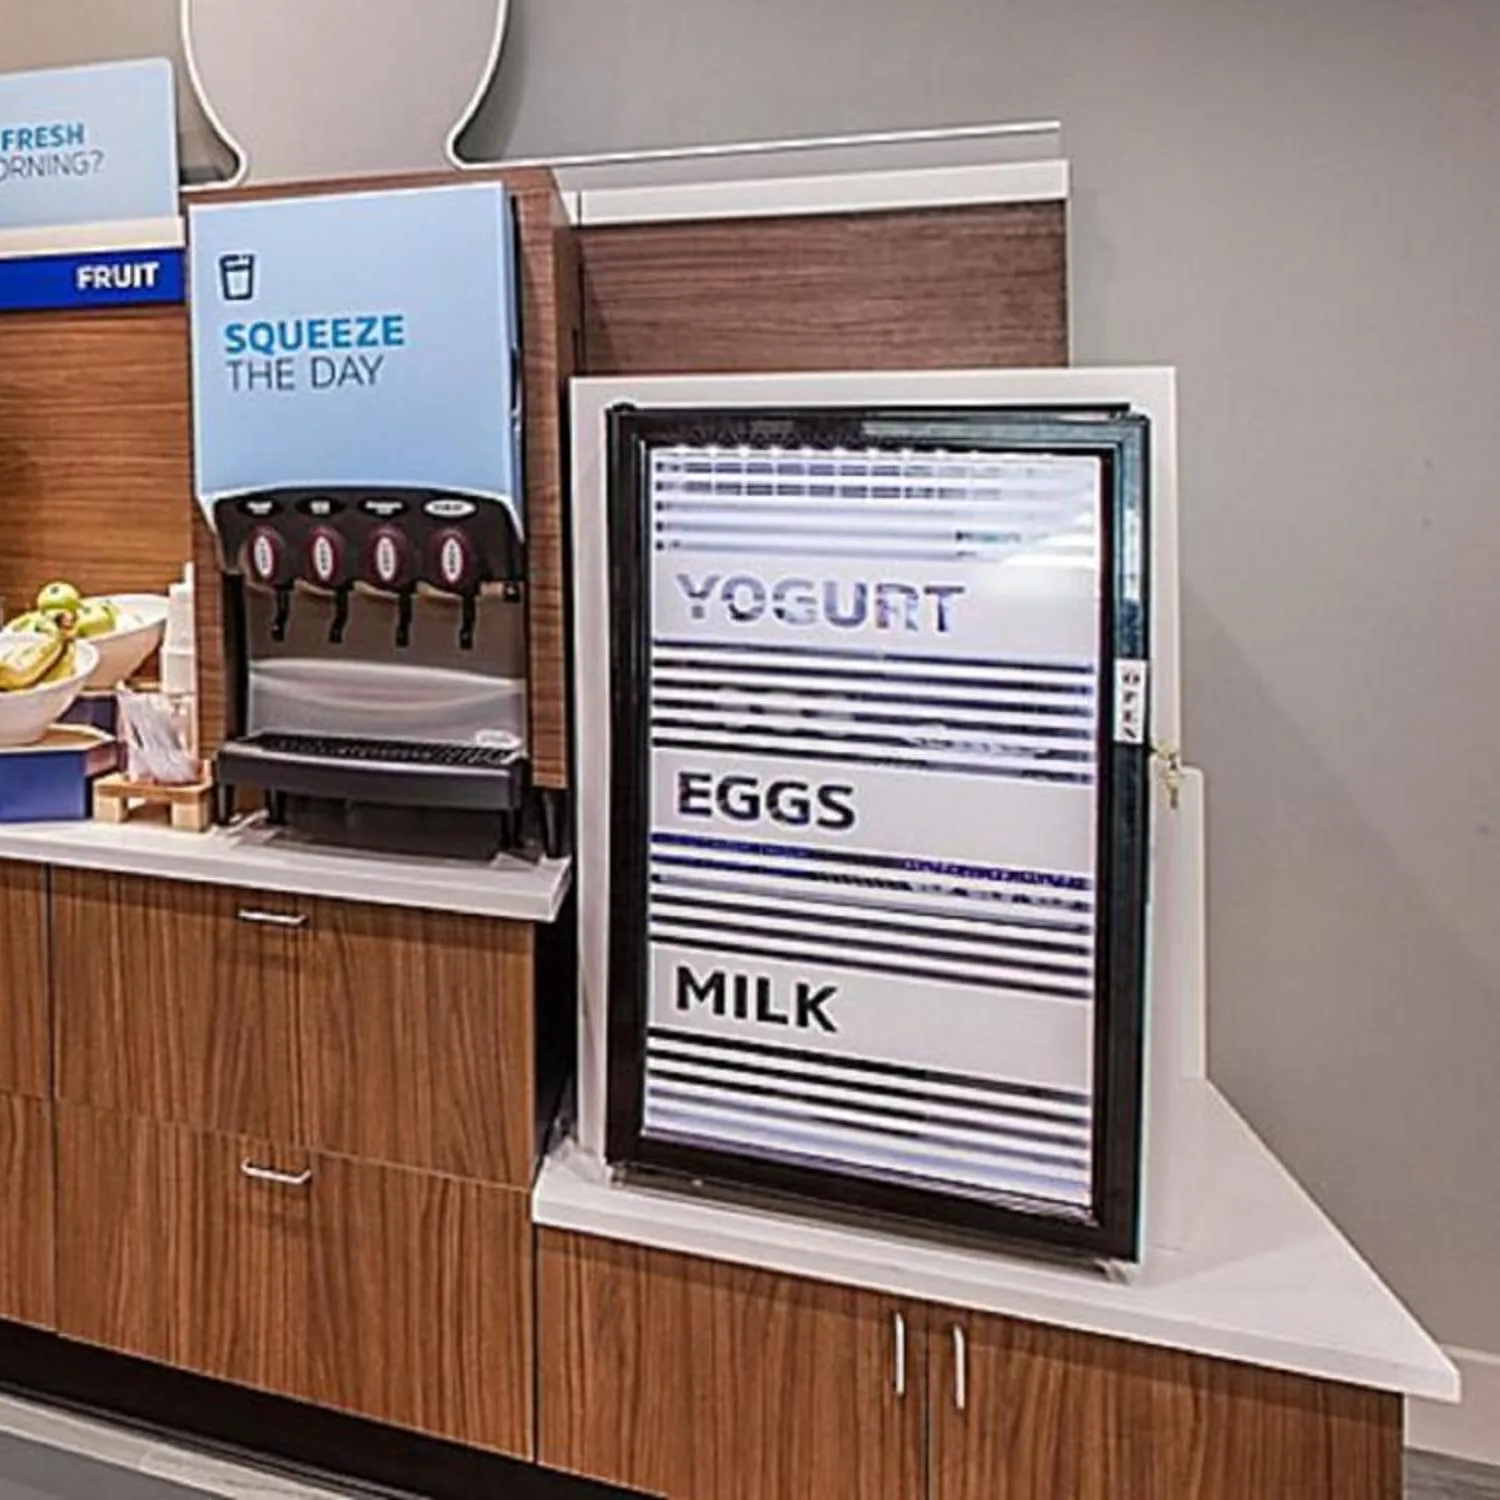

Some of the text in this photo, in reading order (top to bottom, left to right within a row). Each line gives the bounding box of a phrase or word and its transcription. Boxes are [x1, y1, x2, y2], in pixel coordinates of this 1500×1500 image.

[1, 122, 86, 151] FRESH
[76, 261, 160, 290] FRUIT
[224, 314, 406, 356] SQUEEZE
[225, 353, 385, 392] THE DAY
[676, 573, 966, 633] YOGURT
[677, 770, 856, 830] EGGS
[676, 964, 839, 1034] MILK
